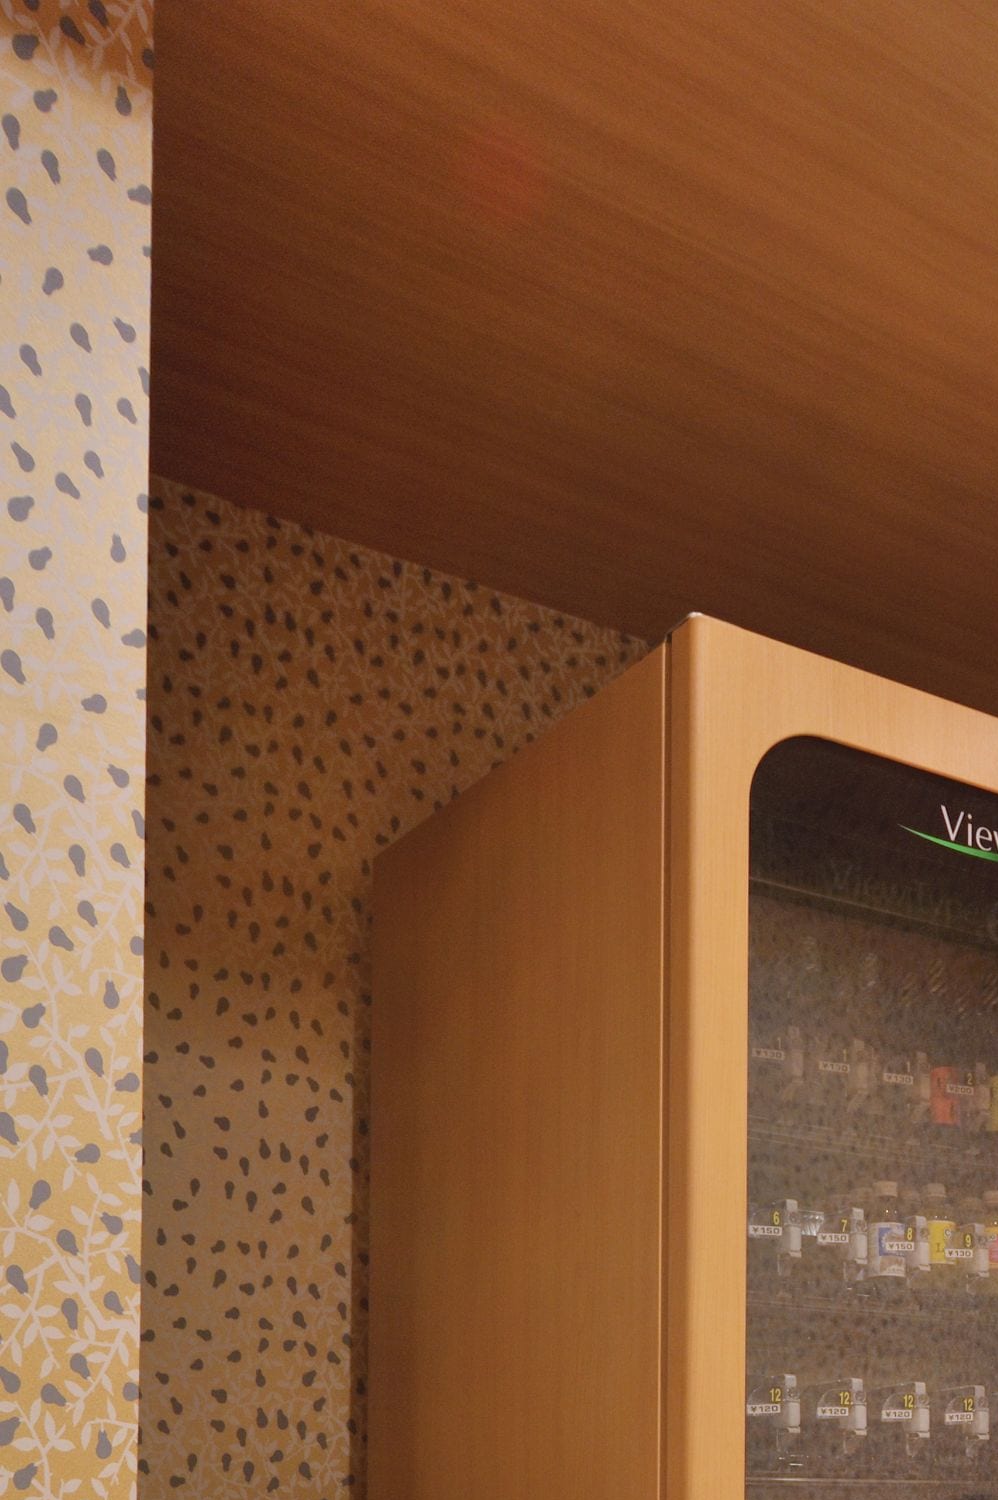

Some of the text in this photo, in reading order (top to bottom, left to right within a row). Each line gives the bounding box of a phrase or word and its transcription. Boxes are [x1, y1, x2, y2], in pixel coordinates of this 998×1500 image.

[773, 1211, 780, 1225] 6
[752, 1227, 780, 1235] ¥150
[841, 1219, 847, 1232] 7
[822, 1234, 847, 1242] ¥150
[907, 1228, 913, 1241] 8
[965, 1234, 971, 1247] 9
[888, 1242, 913, 1250] ¥150
[769, 1388, 781, 1402] 12
[839, 1391, 850, 1405] 12
[903, 1395, 914, 1409] 12
[964, 1398, 974, 1411] 12
[751, 1405, 779, 1413] ¥120
[821, 1408, 847, 1416] ¥120
